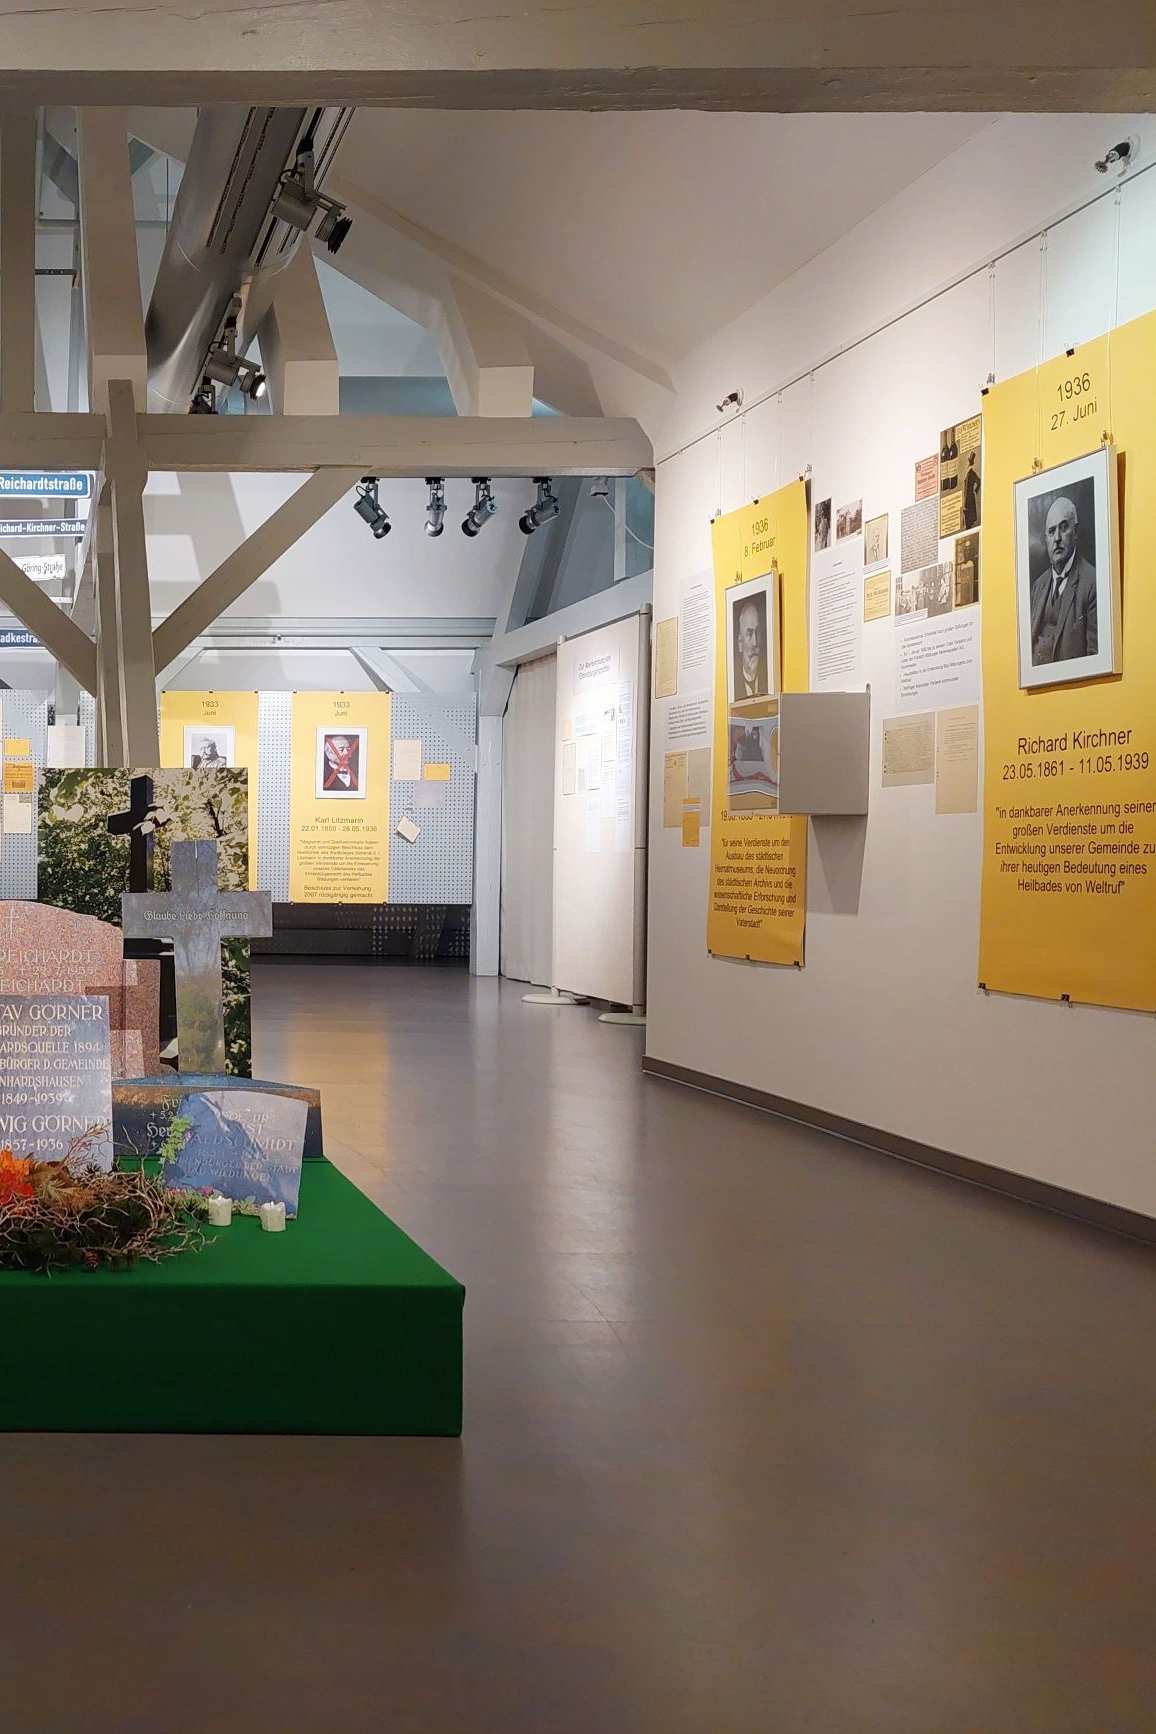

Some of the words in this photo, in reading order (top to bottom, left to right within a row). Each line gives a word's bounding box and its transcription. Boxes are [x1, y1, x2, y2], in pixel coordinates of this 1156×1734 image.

[1056, 372, 1092, 402] 1936
[1050, 410, 1069, 431] 27.
[1073, 396, 1098, 422] Juni
[752, 518, 769, 536] 1936
[752, 536, 775, 553] Februar
[201, 700, 219, 708] 1933
[332, 700, 351, 708] 1933
[1017, 733, 1068, 755] Richard
[1072, 729, 1132, 749] Kirchner
[1002, 760, 1065, 780] 23.05.1861
[1078, 752, 1149, 775] 11.05.1939
[995, 806, 1007, 819] "in
[1008, 805, 1054, 819] dankbarer
[1055, 802, 1121, 818] Anerkennung
[1123, 800, 1156, 814] seiner
[314, 816, 330, 824] Karl
[331, 816, 364, 824] Litzmann
[1012, 824, 1044, 839] großen
[1046, 821, 1098, 836] Verdienste
[1100, 824, 1116, 835] um
[1118, 820, 1134, 835] die
[744, 838, 771, 848] Verdienste
[995, 842, 1047, 858] Entwicklung
[1049, 844, 1085, 855] unserer
[1087, 840, 1140, 855] Gemeinde
[1142, 843, 1156, 854] zu
[725, 851, 744, 860] Ausbau
[744, 851, 755, 860] des
[1000, 860, 1020, 873] ihrer
[1021, 860, 1061, 876] heutigen
[1063, 860, 1117, 877] Bedeutung
[1119, 861, 1148, 875] eines
[1017, 878, 1063, 893] Heilbades
[1065, 881, 1083, 893] von
[1085, 880, 1126, 895] Weltruf"
[29, 1003, 104, 1021] GÖRNER
[50, 1025, 72, 1037] DER
[73, 1041, 101, 1053] 1894
